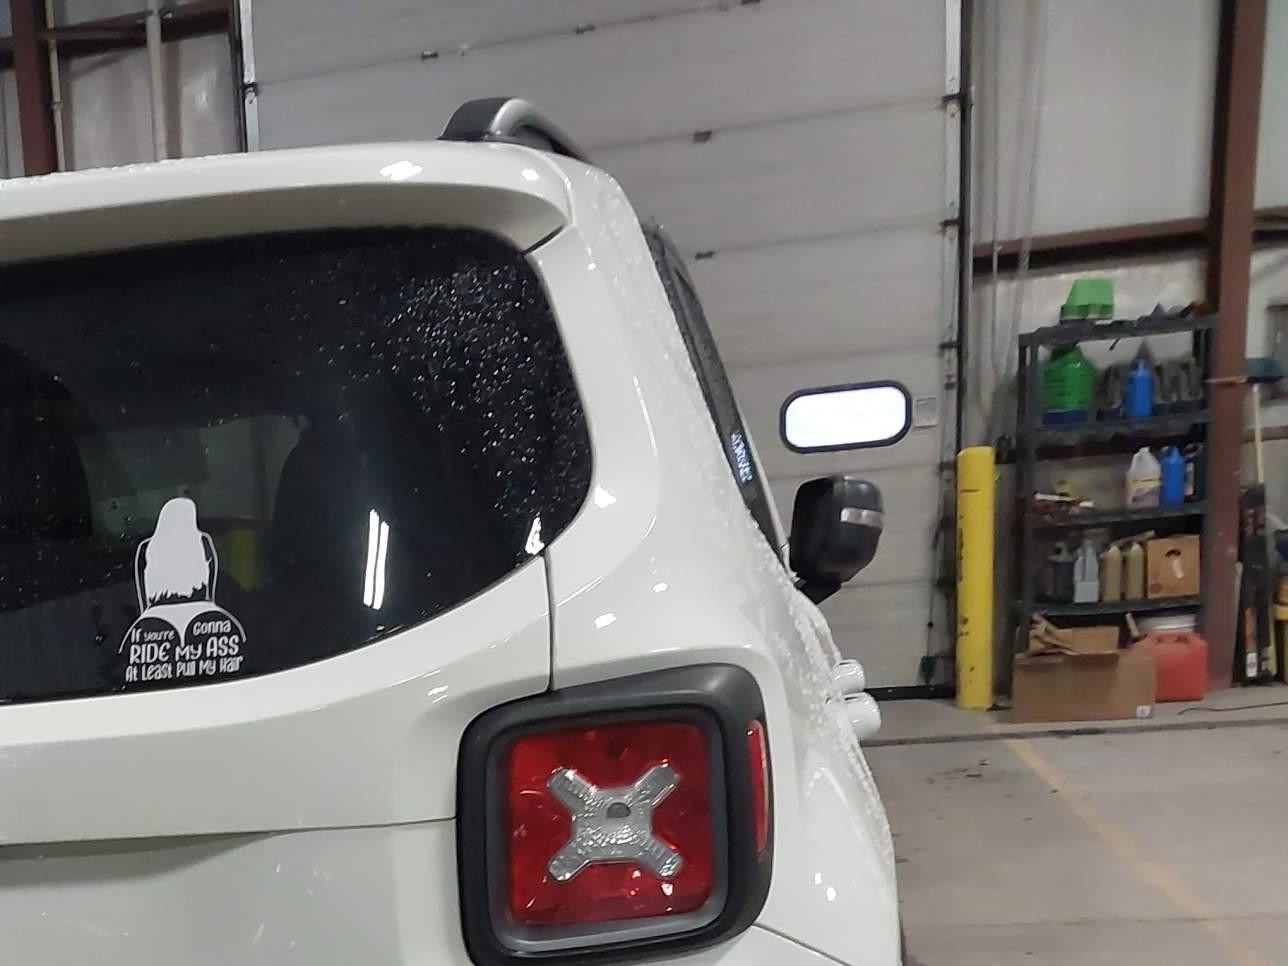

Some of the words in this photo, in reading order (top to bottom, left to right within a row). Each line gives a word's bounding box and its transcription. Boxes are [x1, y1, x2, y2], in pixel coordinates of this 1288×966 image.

[131, 628, 142, 643] If
[192, 620, 231, 636] Gonna
[129, 642, 171, 664] RIDE
[206, 635, 239, 658] ASS
[125, 665, 138, 682] At
